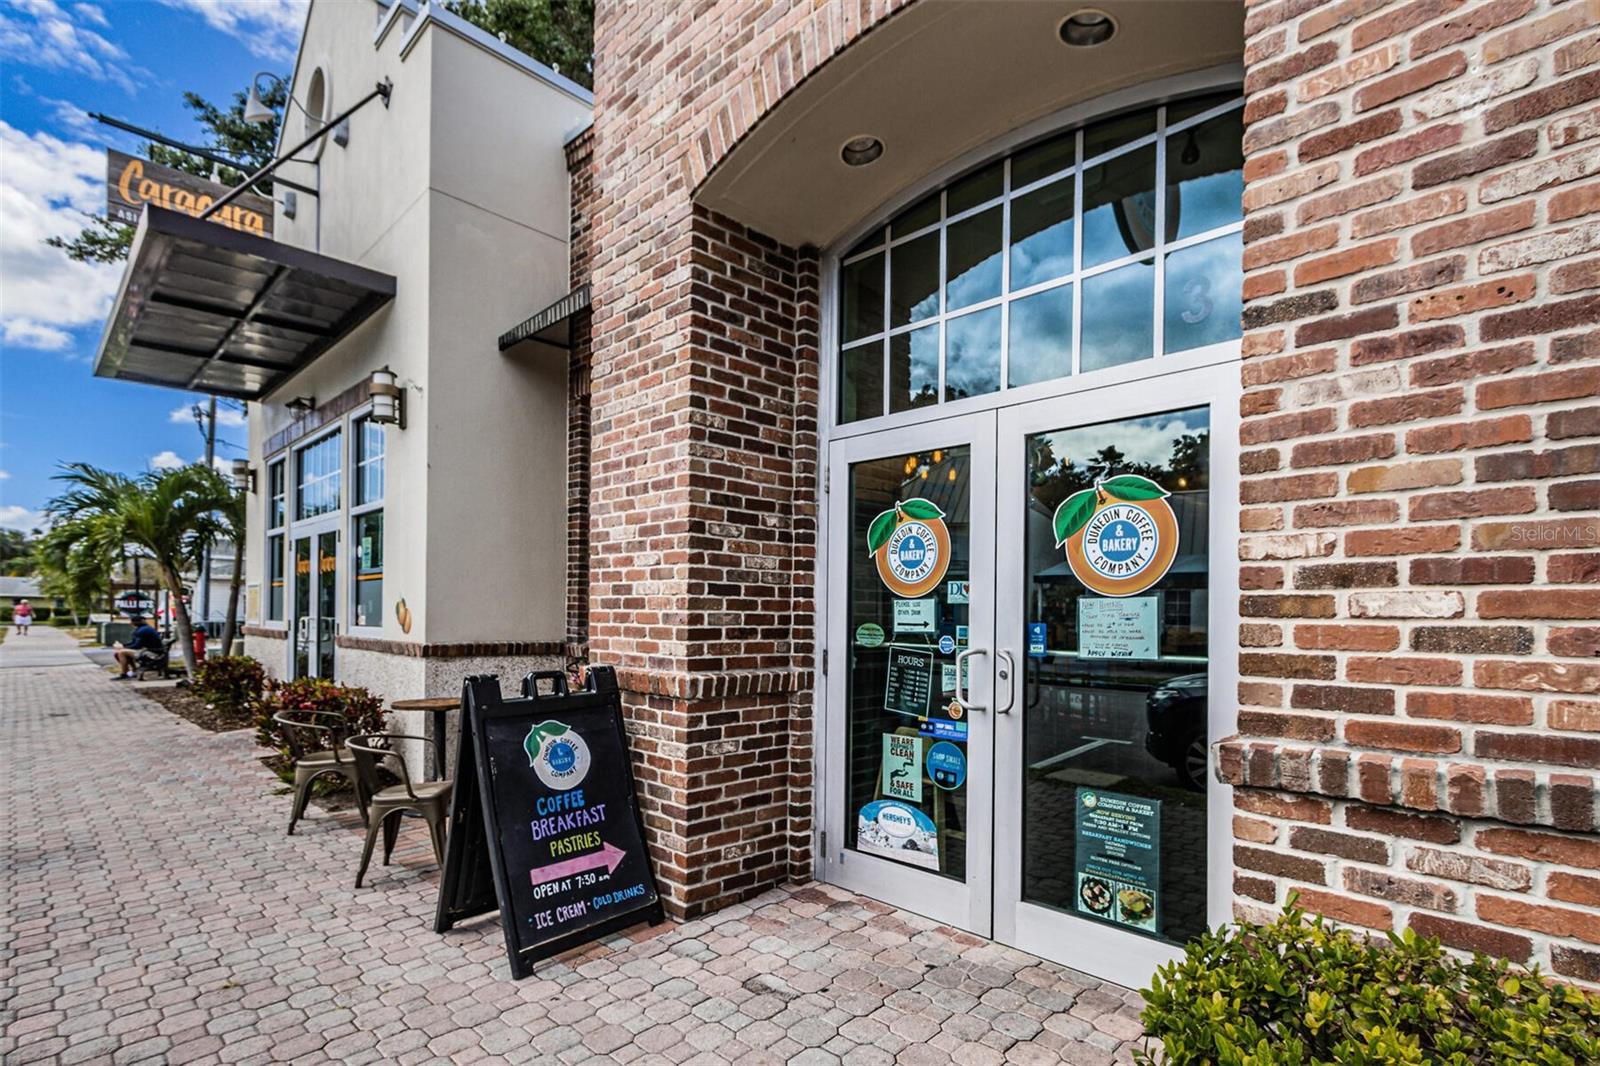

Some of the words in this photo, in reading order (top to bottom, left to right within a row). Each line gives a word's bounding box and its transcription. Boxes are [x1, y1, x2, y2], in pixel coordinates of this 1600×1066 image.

[117, 210, 138, 224] ASI
[1088, 508, 1120, 544] DUNEDIN
[1126, 509, 1154, 542] COFFEE
[1115, 524, 1124, 537] &
[891, 526, 912, 554] DUNEDIN
[916, 526, 934, 552] COFFEE
[909, 538, 914, 548] &
[1102, 537, 1138, 552] BAKERY
[900, 550, 924, 561] BAKERY
[1094, 552, 1146, 574] COMPANY
[895, 562, 930, 579] COMPANY
[898, 655, 924, 668] HOURS
[560, 737, 578, 751] COFFEE
[890, 748, 914, 759] CLEAN
[551, 765, 576, 778] COMPANY
[896, 780, 914, 790] SAFE
[890, 787, 902, 795] FOR
[902, 790, 914, 798] ALL
[536, 789, 585, 816] COFFEE
[530, 804, 606, 841] BREAKFAST
[550, 831, 601, 857] PASTRIES
[533, 881, 559, 899] OPEN
[561, 879, 572, 892] AT
[576, 873, 596, 888] 7:30
[534, 910, 554, 929] ICE
[556, 900, 587, 923] CREAM
[593, 894, 612, 910] COLD
[614, 884, 645, 903] DRINKS
